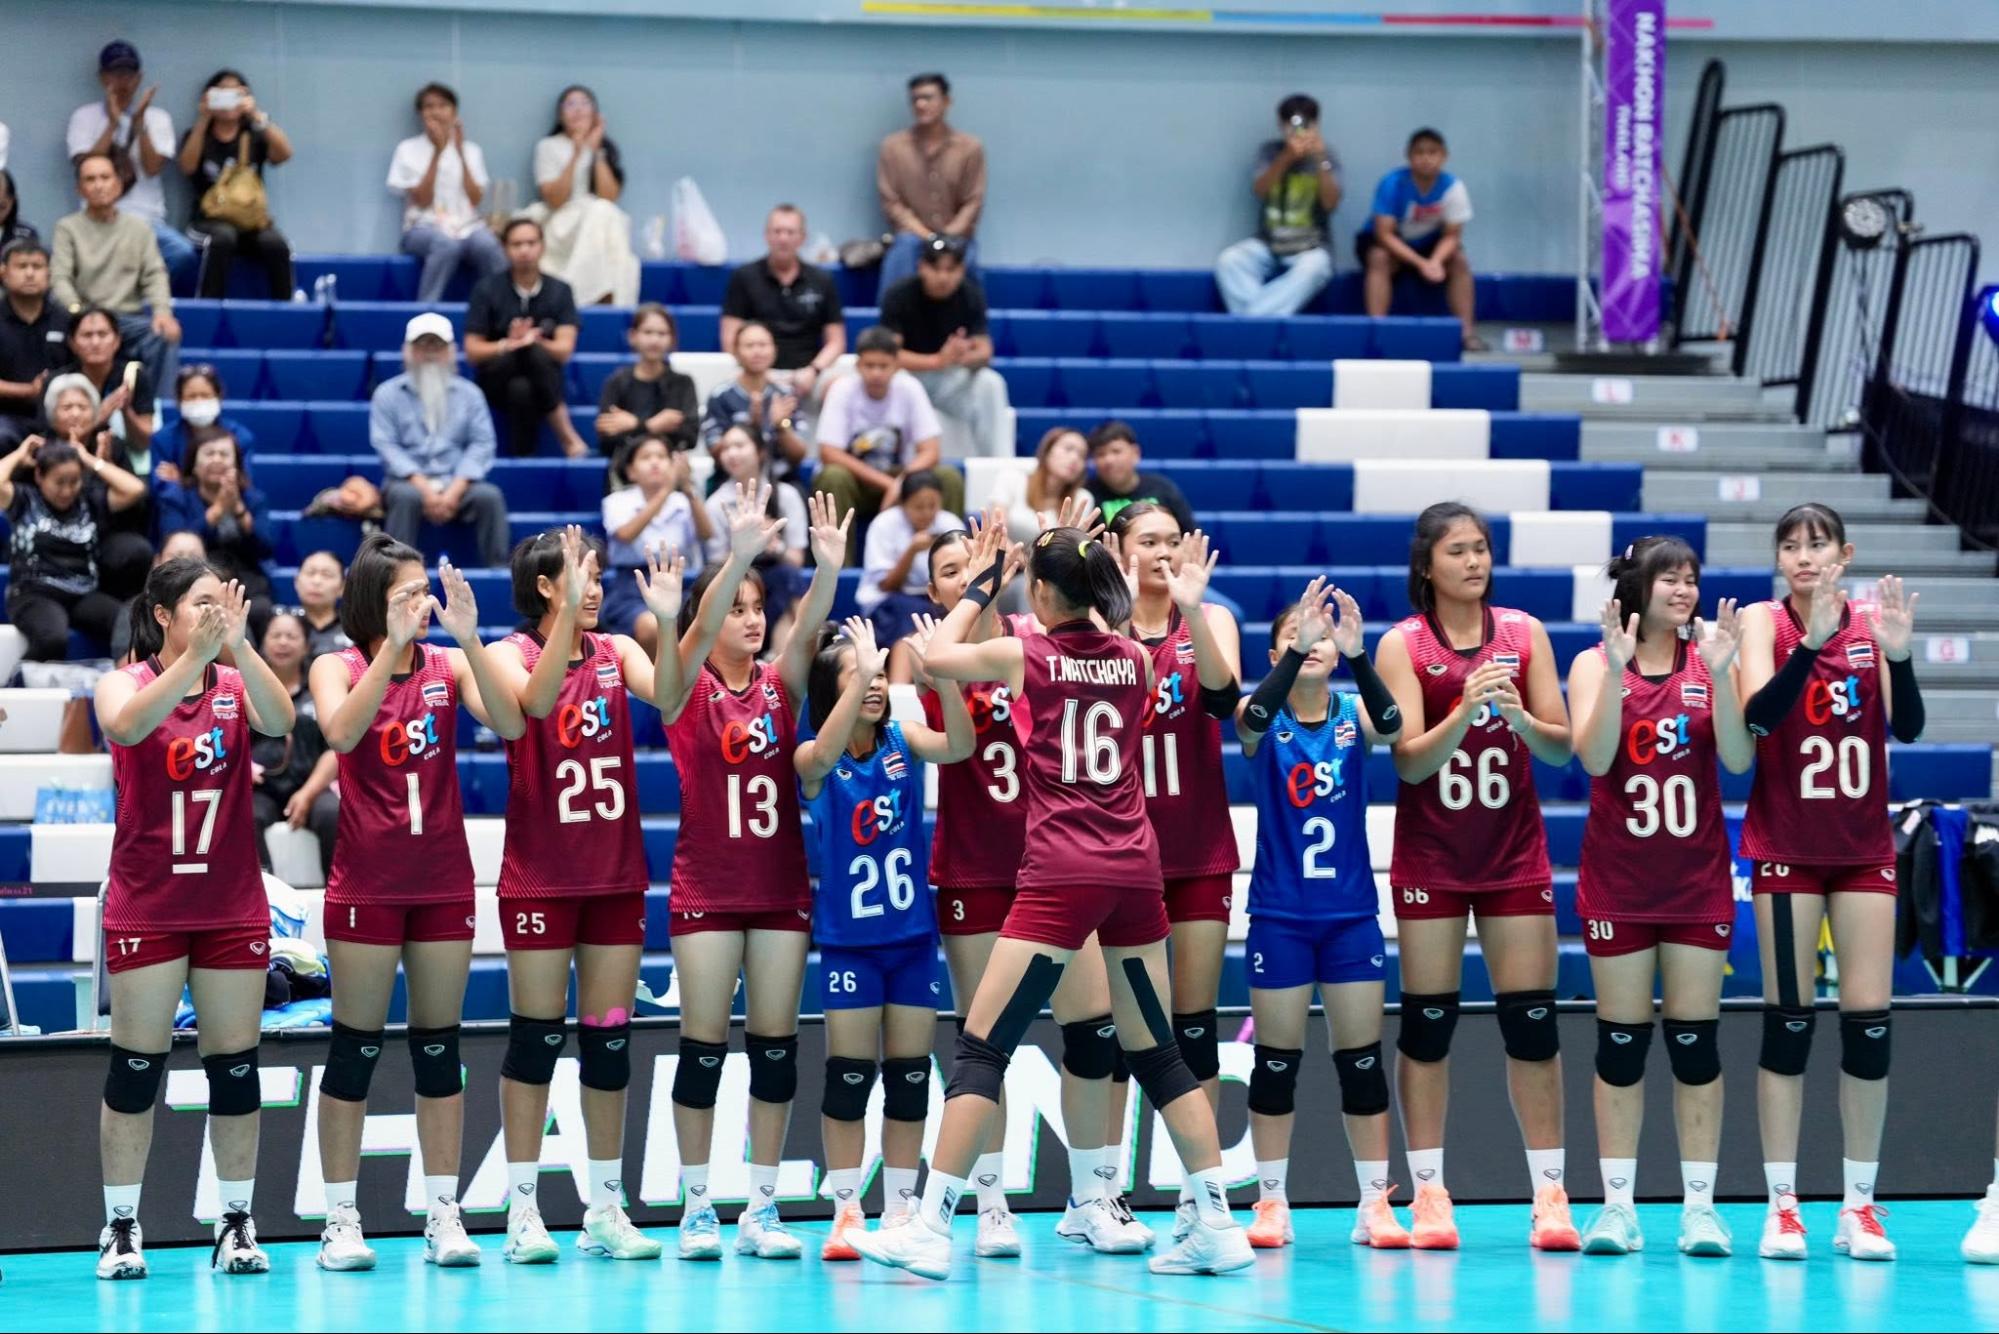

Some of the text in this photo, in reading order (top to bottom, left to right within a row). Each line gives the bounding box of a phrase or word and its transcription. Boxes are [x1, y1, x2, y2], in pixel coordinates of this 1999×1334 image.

[1630, 12, 1656, 279] NAKHON RATCHASIMA
[557, 696, 611, 749] est
[969, 686, 1012, 735] es
[1805, 675, 1862, 725] est
[167, 726, 227, 781] est
[380, 712, 440, 766] est
[721, 713, 778, 765] est
[1060, 699, 1124, 784] 16
[1142, 733, 1181, 797] 11
[1628, 713, 1692, 765] est
[1799, 735, 1870, 799] 20
[555, 756, 626, 824] 25
[982, 742, 1021, 803] 3
[1287, 758, 1344, 808] est
[1439, 747, 1511, 810] 66
[172, 789, 223, 855] 17
[405, 772, 424, 836] 1
[727, 774, 780, 839] 13
[851, 788, 904, 846] est
[1624, 774, 1698, 838] 30
[1301, 816, 1337, 879] 2
[848, 848, 917, 920] 26
[952, 899, 966, 921] 3
[118, 937, 142, 956] 17
[516, 912, 546, 934] 25
[1588, 919, 1615, 941] 30
[829, 970, 857, 994] 26
[1254, 952, 1265, 973] 2
